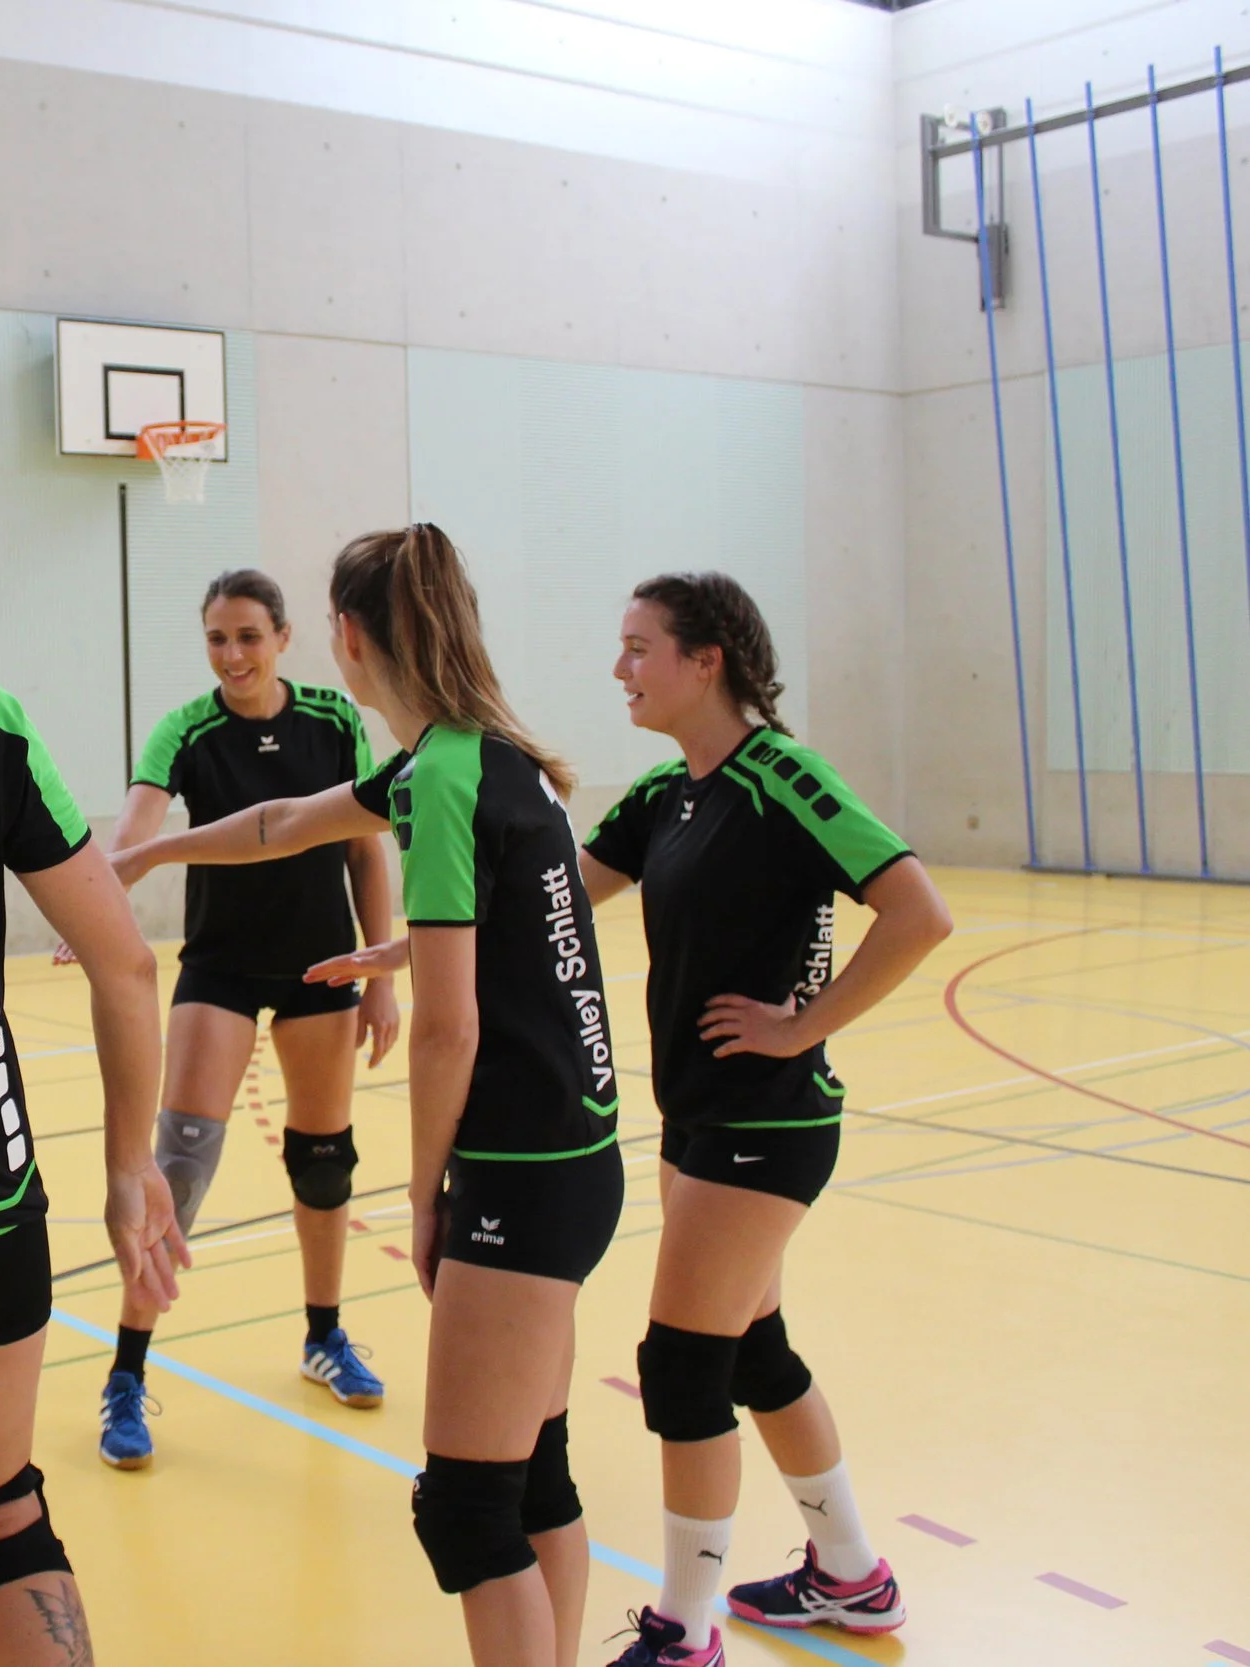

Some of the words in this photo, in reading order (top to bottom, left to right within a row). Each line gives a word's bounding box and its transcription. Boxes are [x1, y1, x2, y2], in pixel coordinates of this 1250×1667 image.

[541, 863, 586, 982] Schlatt
[571, 989, 613, 1092] Volley
[471, 1231, 505, 1245] erima
